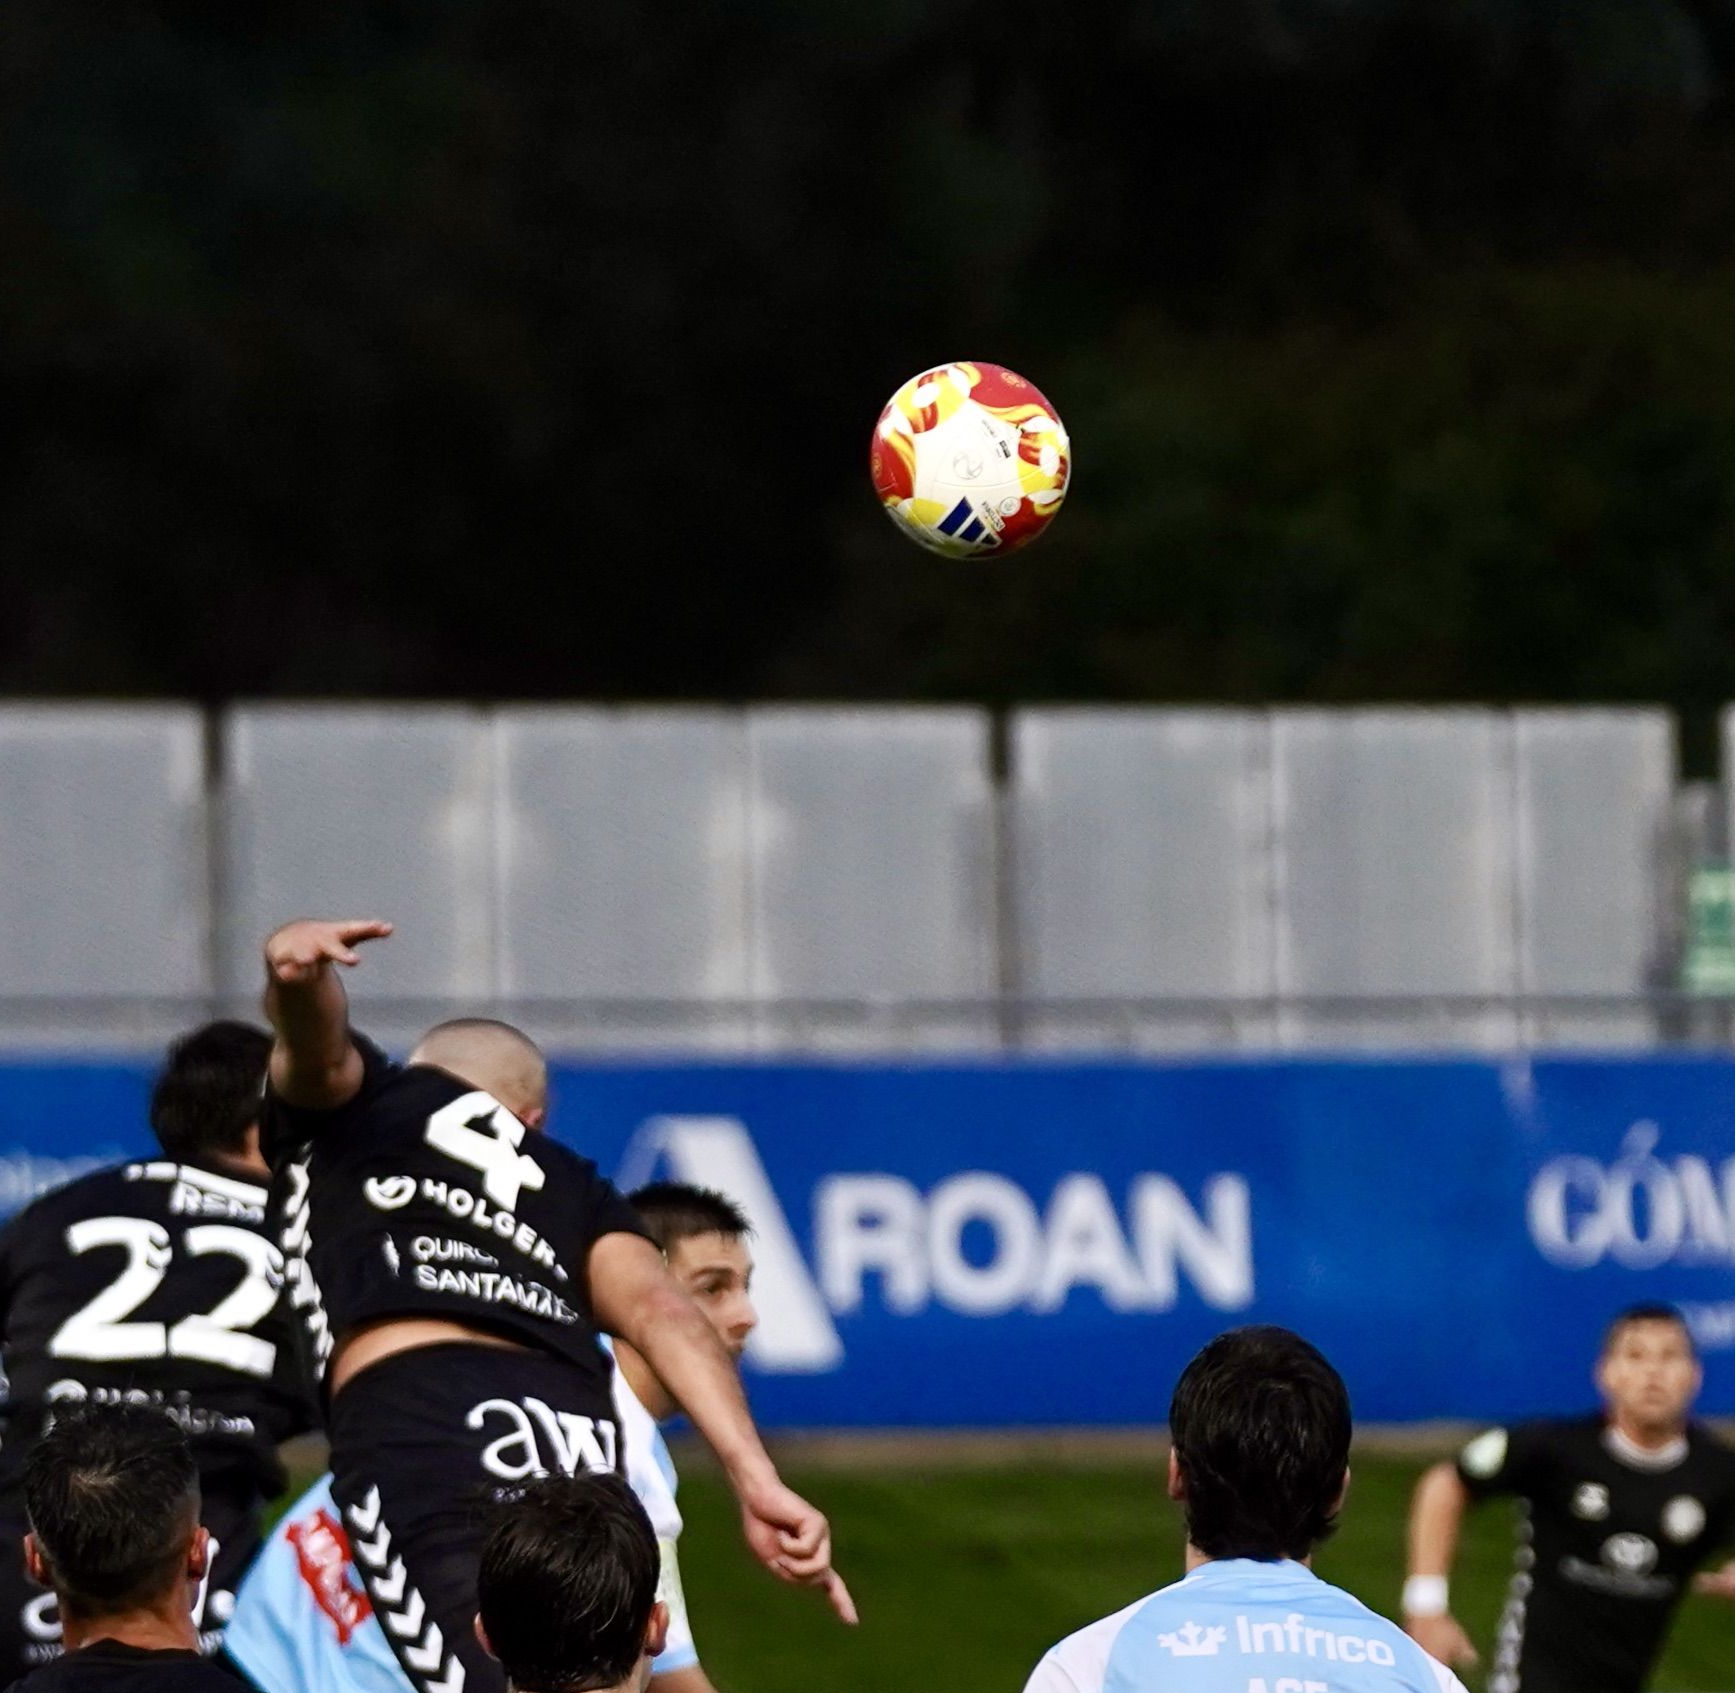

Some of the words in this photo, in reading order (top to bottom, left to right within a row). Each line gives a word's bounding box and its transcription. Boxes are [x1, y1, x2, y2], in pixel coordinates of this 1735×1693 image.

[425, 1090, 546, 1212] 4
[49, 1216, 289, 1379] 22
[1237, 1614, 1396, 1667] Infrico
